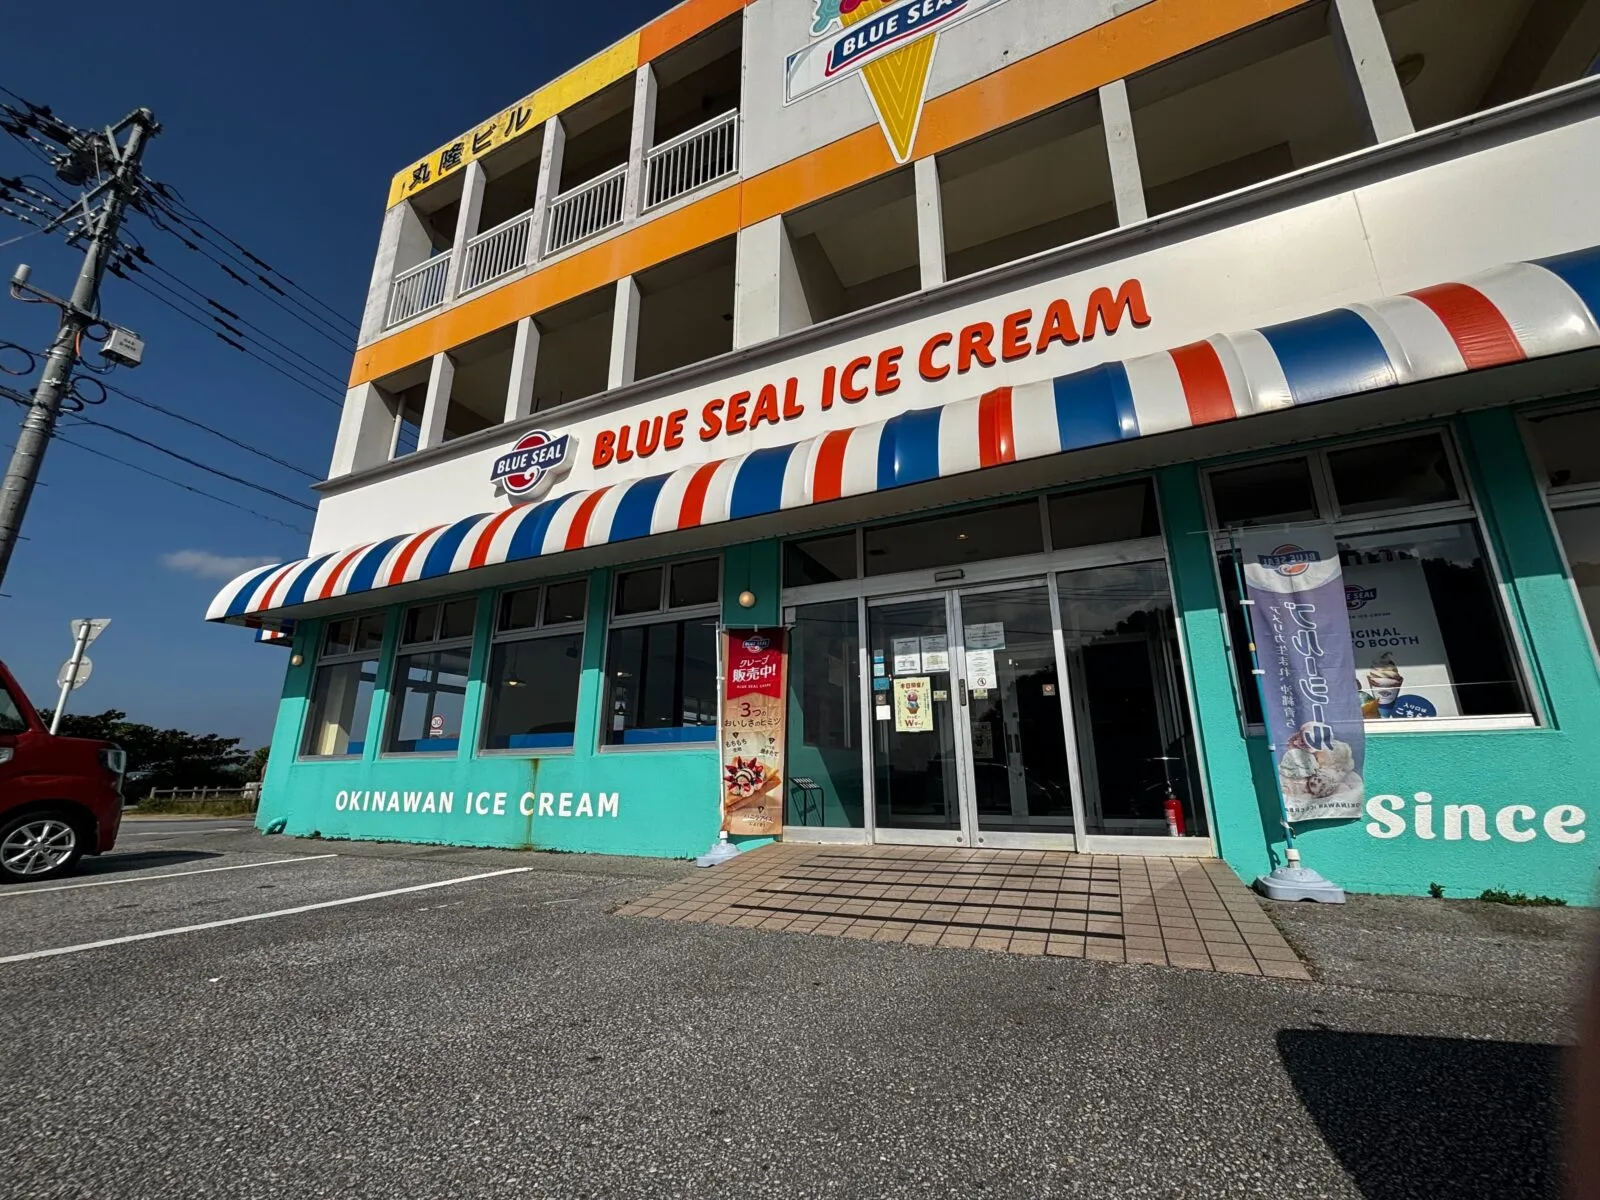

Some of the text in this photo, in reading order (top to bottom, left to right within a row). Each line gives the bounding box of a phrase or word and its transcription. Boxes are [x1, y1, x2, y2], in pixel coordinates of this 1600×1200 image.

[842, 14, 900, 57] BLUE
[408, 106, 533, 191] 丸隆ビル
[591, 278, 1152, 470] BLUE SEAL ICE CREAM
[496, 444, 562, 475] BLUE SEAL
[1353, 591, 1375, 600] SEAL
[1351, 627, 1400, 639] IGINAL
[1368, 636, 1420, 648] BOOTH
[740, 654, 770, 668] クレープ
[740, 702, 767, 718] 3つの
[724, 718, 781, 727] おいしさのヒミツ
[335, 790, 620, 817] OKINAWAN ICE CREAM
[1365, 791, 1586, 844] Since
